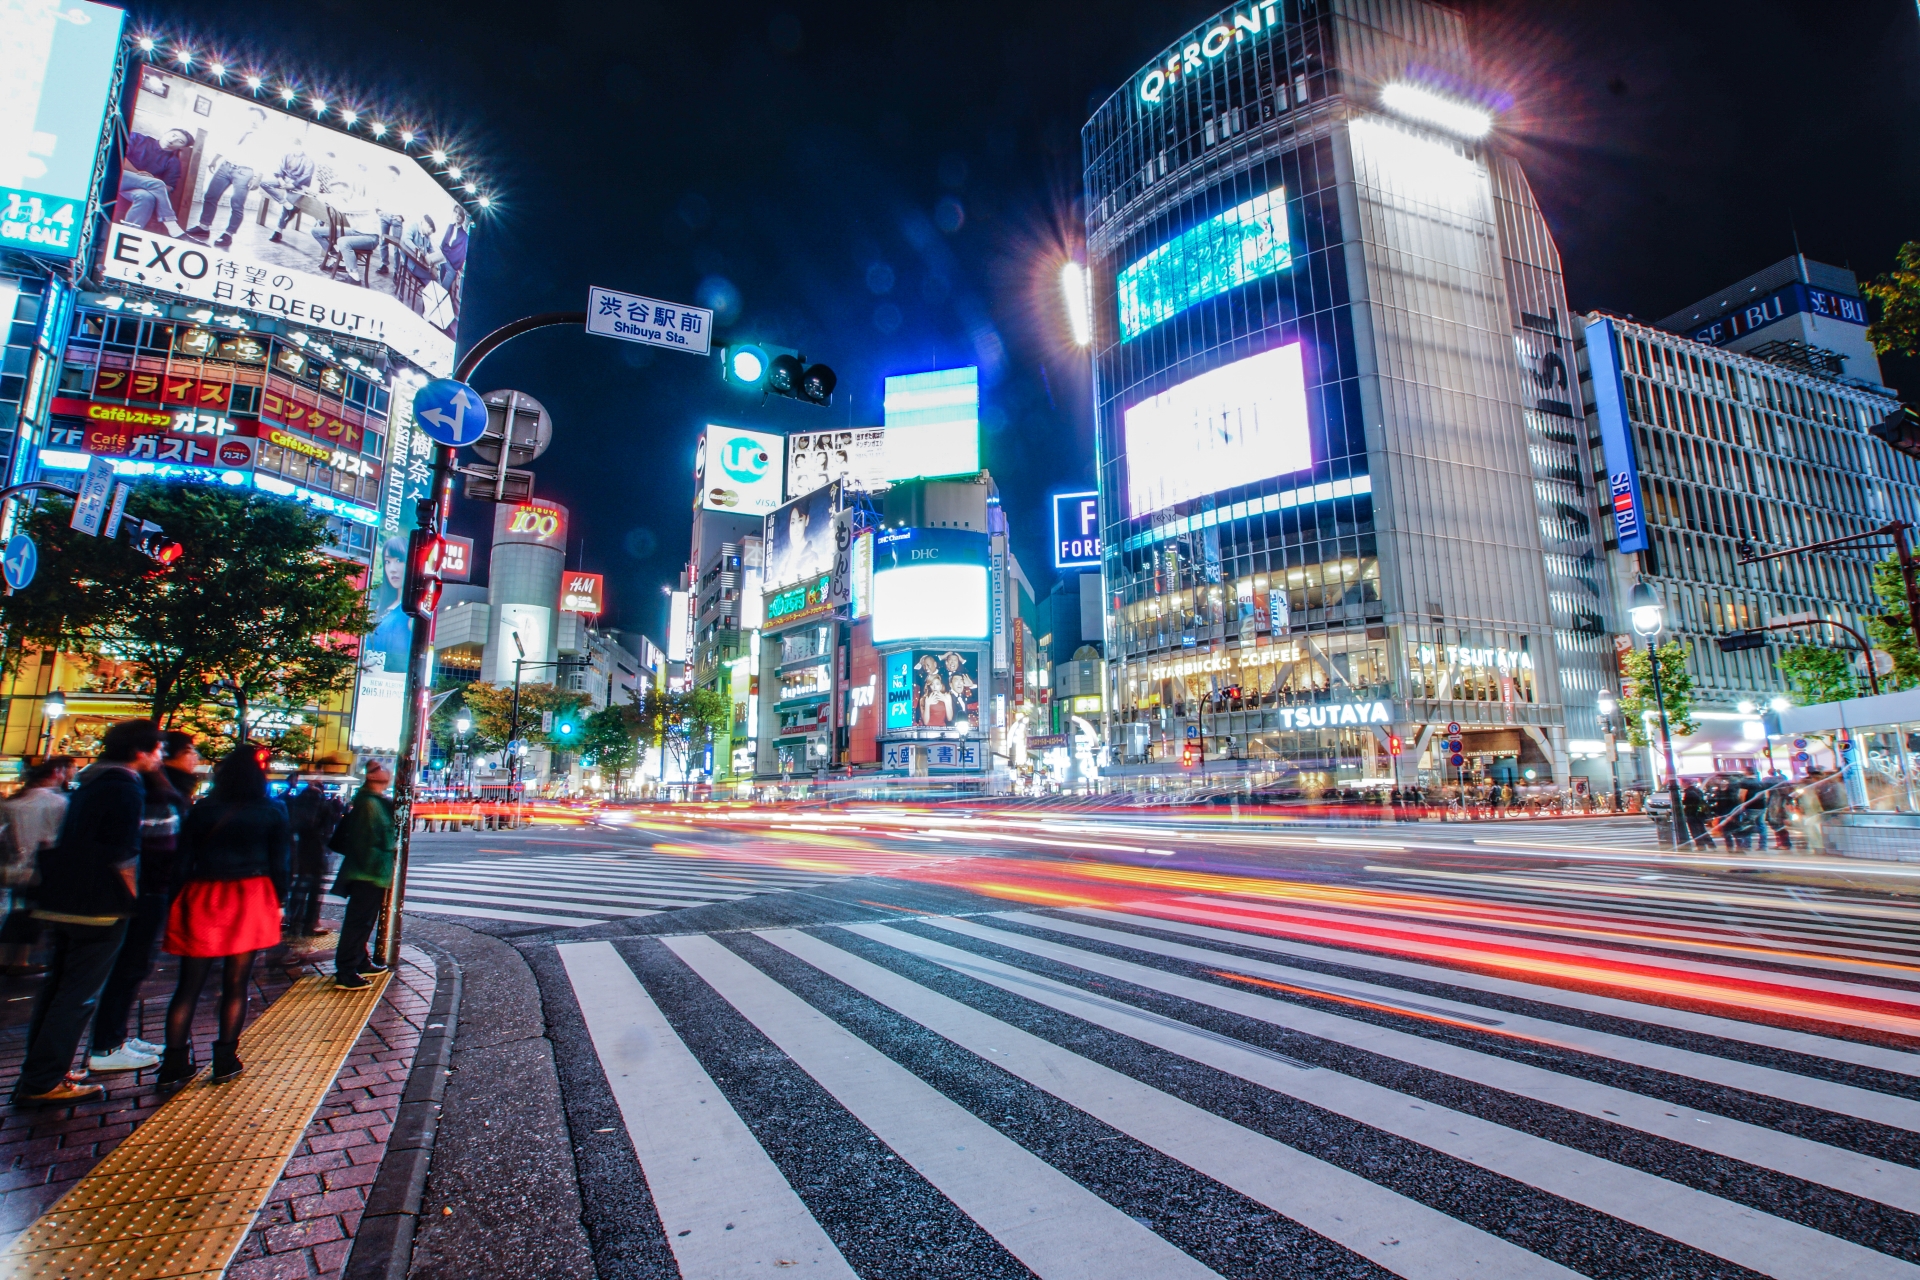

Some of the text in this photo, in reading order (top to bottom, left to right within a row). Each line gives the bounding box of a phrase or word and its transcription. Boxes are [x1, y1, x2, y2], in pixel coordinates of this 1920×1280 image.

[8, 193, 74, 229] 11.4
[1, 220, 71, 248] ON SALE
[113, 231, 209, 280] EXO
[215, 258, 294, 291] 待望の
[599, 295, 702, 334] 渋谷駅前
[1696, 296, 1785, 347] SEIBU
[1810, 291, 1864, 323] SEIBU
[614, 321, 689, 345] Shibuya Sta.
[99, 371, 225, 403] プライス
[89, 405, 237, 436] Caféレストラン ガスト
[263, 393, 359, 443] コンタクト
[51, 427, 84, 445] 7F
[90, 444, 125, 454] レストラン
[91, 432, 127, 447] Café
[129, 435, 208, 463] ガスト
[222, 451, 248, 460] ガスト
[270, 431, 373, 477] Caféレストラン ガスト
[407, 424, 433, 504] 樹奈々
[385, 467, 405, 532] ANTHEMS
[520, 505, 558, 517] SHIBUYA
[756, 499, 777, 508] VISA
[1610, 471, 1637, 540] SEIBU
[509, 511, 559, 541] 109
[1081, 500, 1096, 535] F
[889, 532, 911, 543] Channel
[835, 521, 851, 601] もんじゃ
[911, 548, 939, 560] DHC
[569, 577, 595, 594] H&M
[994, 599, 1002, 635] neon
[1152, 648, 1301, 680] STARBUCKS COFFEE
[1447, 647, 1533, 669] TSUTAYA
[370, 679, 384, 687] NEW
[889, 689, 911, 703] DMM
[892, 702, 908, 716] FX
[1280, 701, 1390, 728] TSUTAYA
[887, 745, 975, 764] 大盛書店
